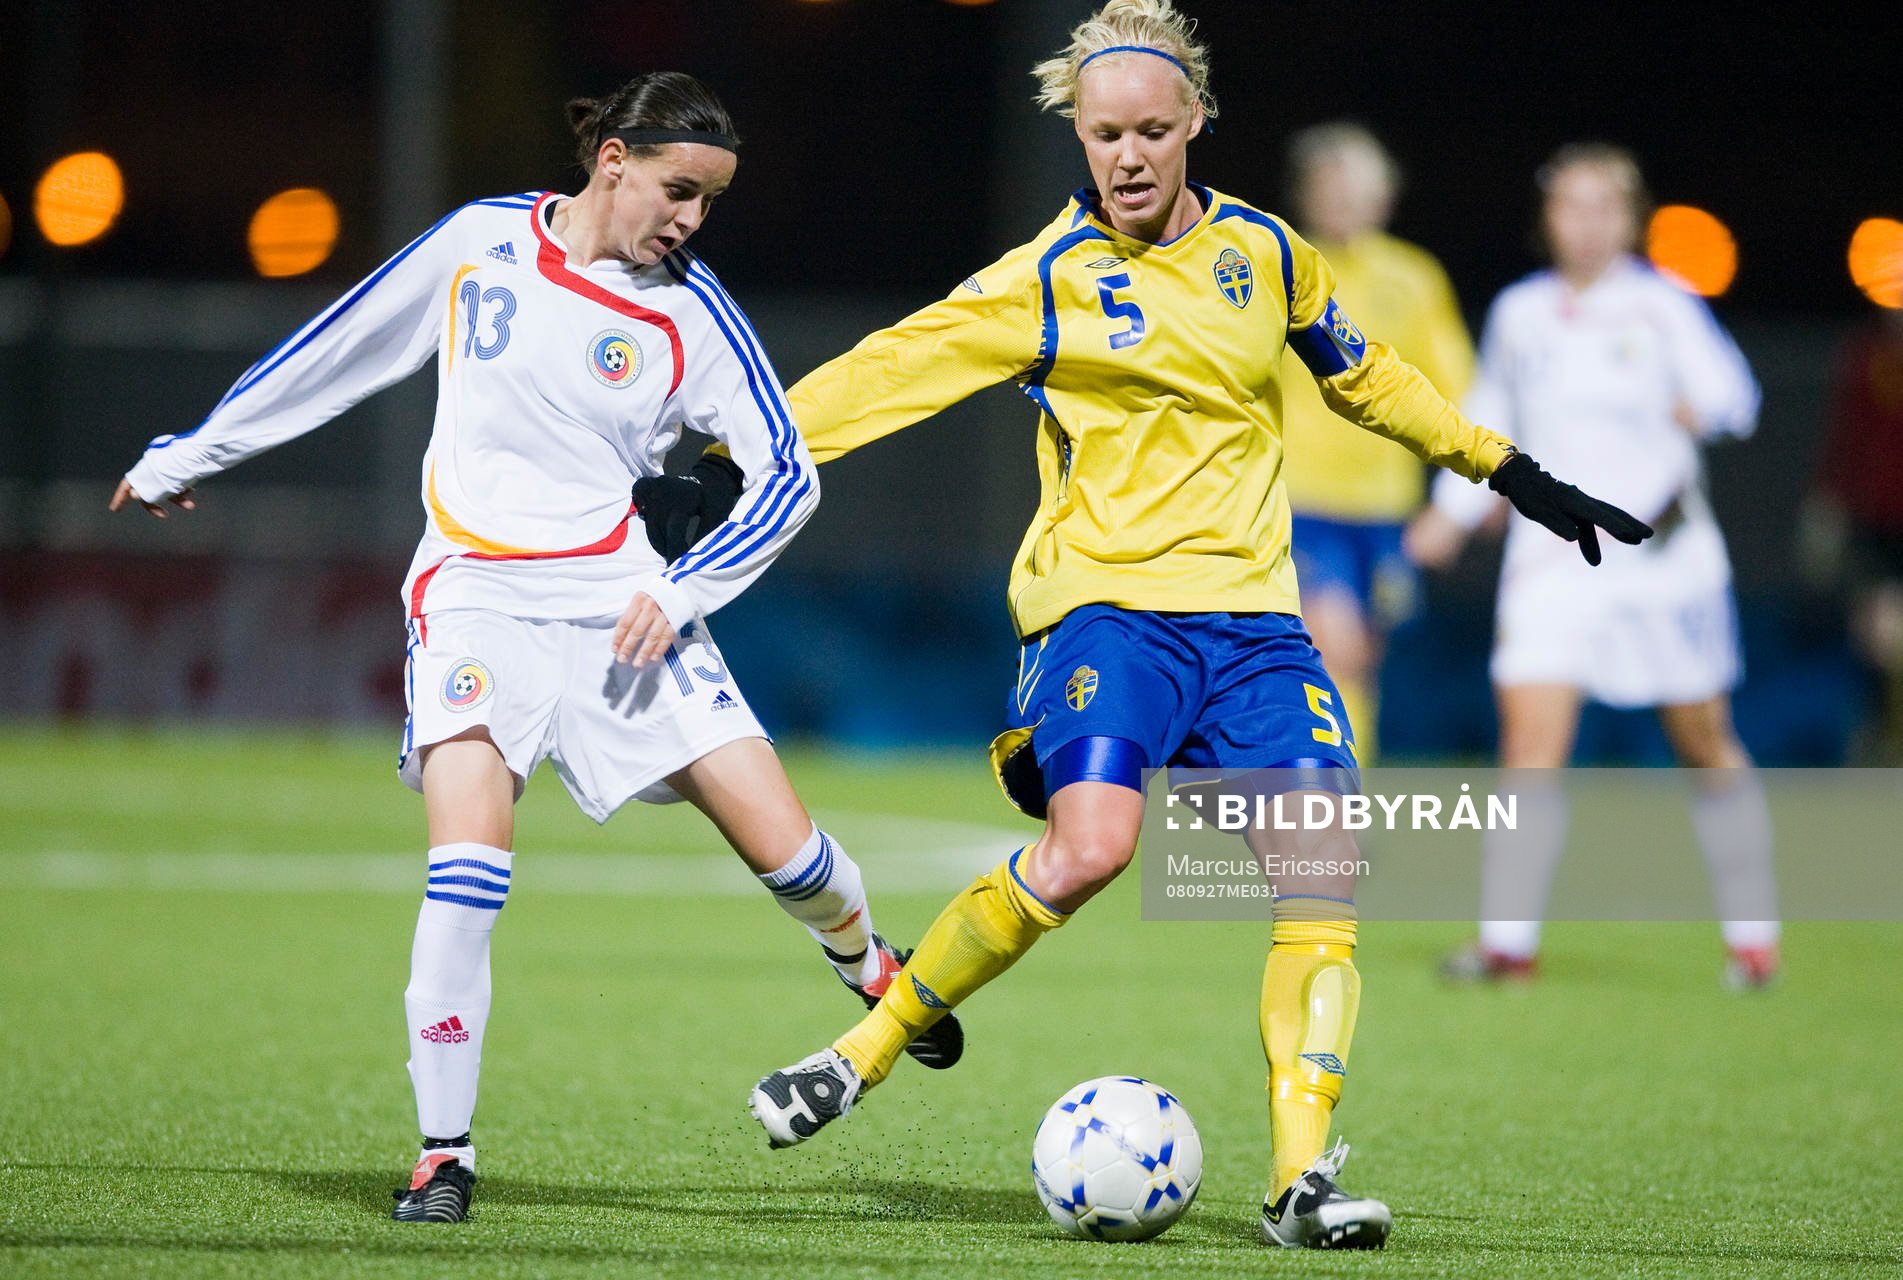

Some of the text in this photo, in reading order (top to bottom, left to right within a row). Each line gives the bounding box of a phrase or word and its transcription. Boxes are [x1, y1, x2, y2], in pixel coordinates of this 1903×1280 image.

[486, 248, 518, 266] adidas
[460, 280, 517, 361] 13
[1096, 272, 1146, 350] 5
[1303, 682, 1342, 747] 5
[420, 1029, 469, 1044] adidas
